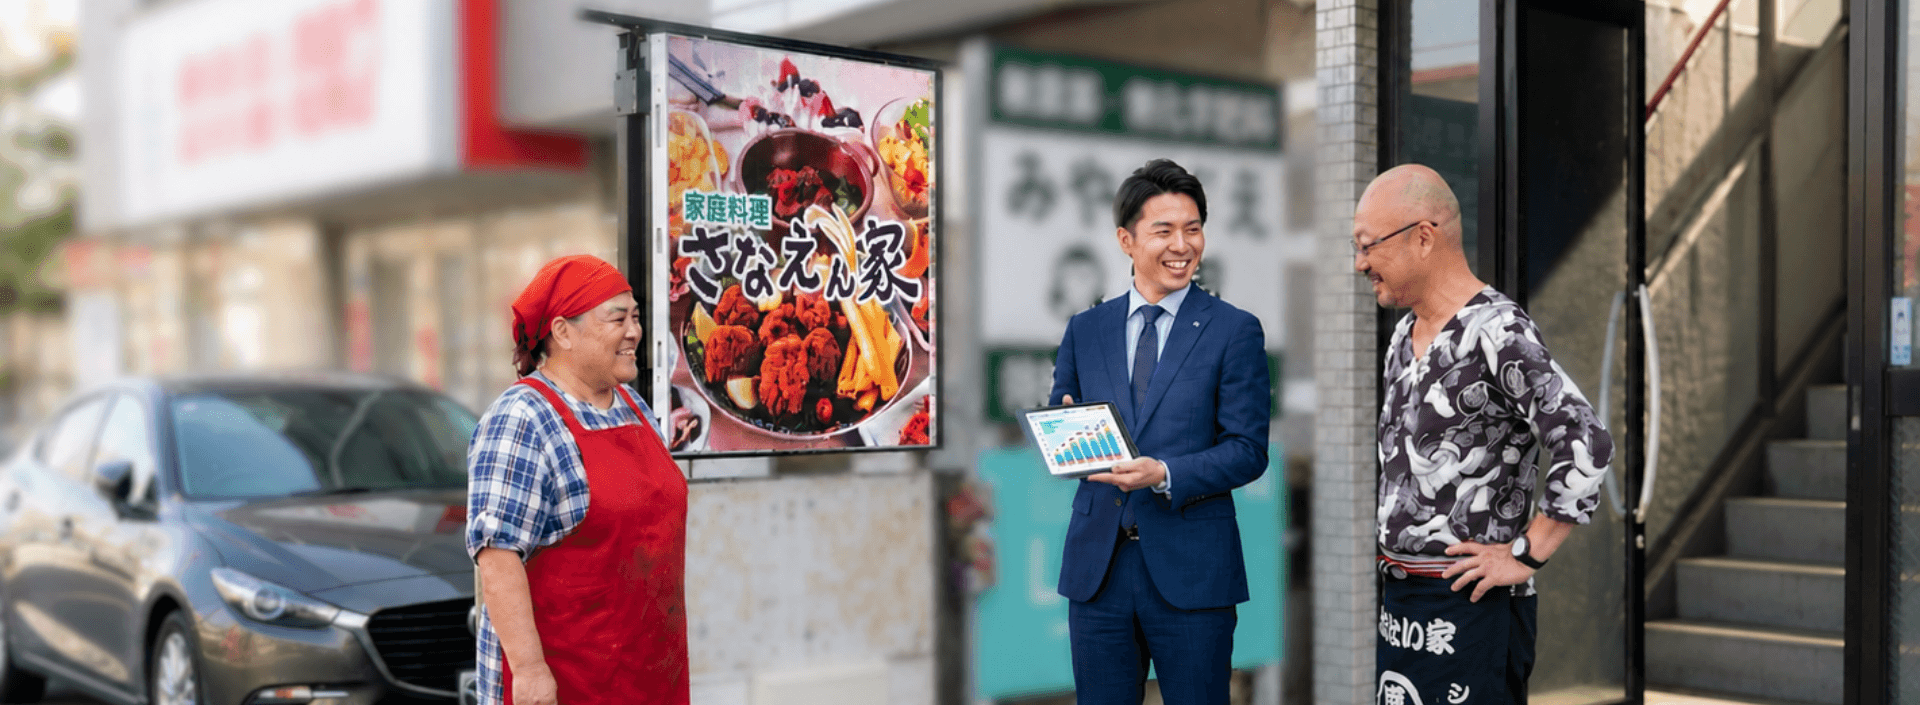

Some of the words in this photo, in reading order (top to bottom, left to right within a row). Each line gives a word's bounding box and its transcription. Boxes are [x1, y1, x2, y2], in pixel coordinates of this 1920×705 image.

[684, 191, 770, 227] 家庭料理
[680, 219, 920, 302] さなえん家
